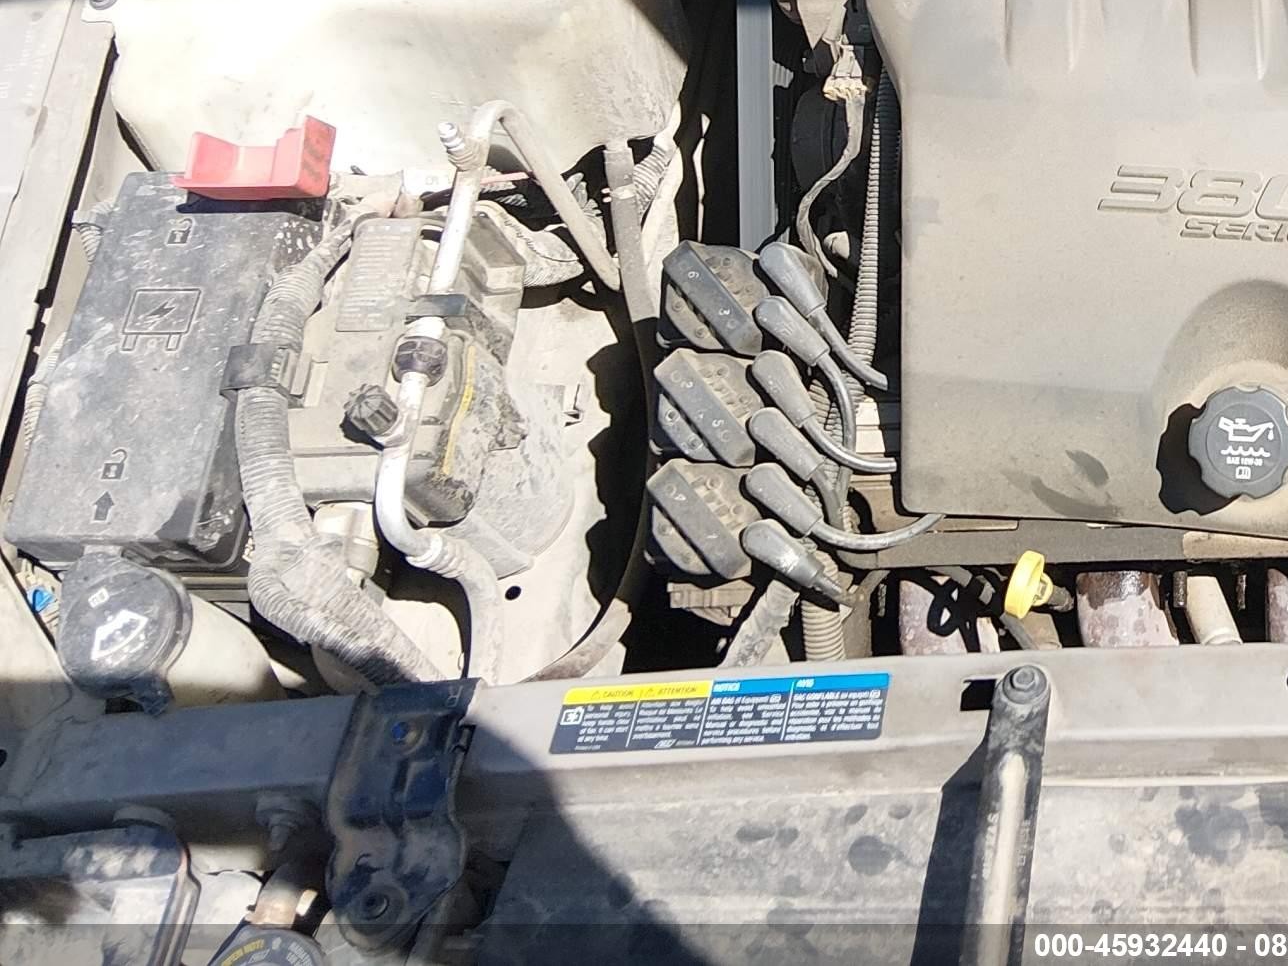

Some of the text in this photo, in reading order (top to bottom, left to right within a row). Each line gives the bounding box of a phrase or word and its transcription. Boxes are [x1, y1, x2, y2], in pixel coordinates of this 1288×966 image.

[657, 687, 697, 696] ATTENTION
[713, 682, 740, 692] NOTICE
[603, 689, 634, 698] CAUTION
